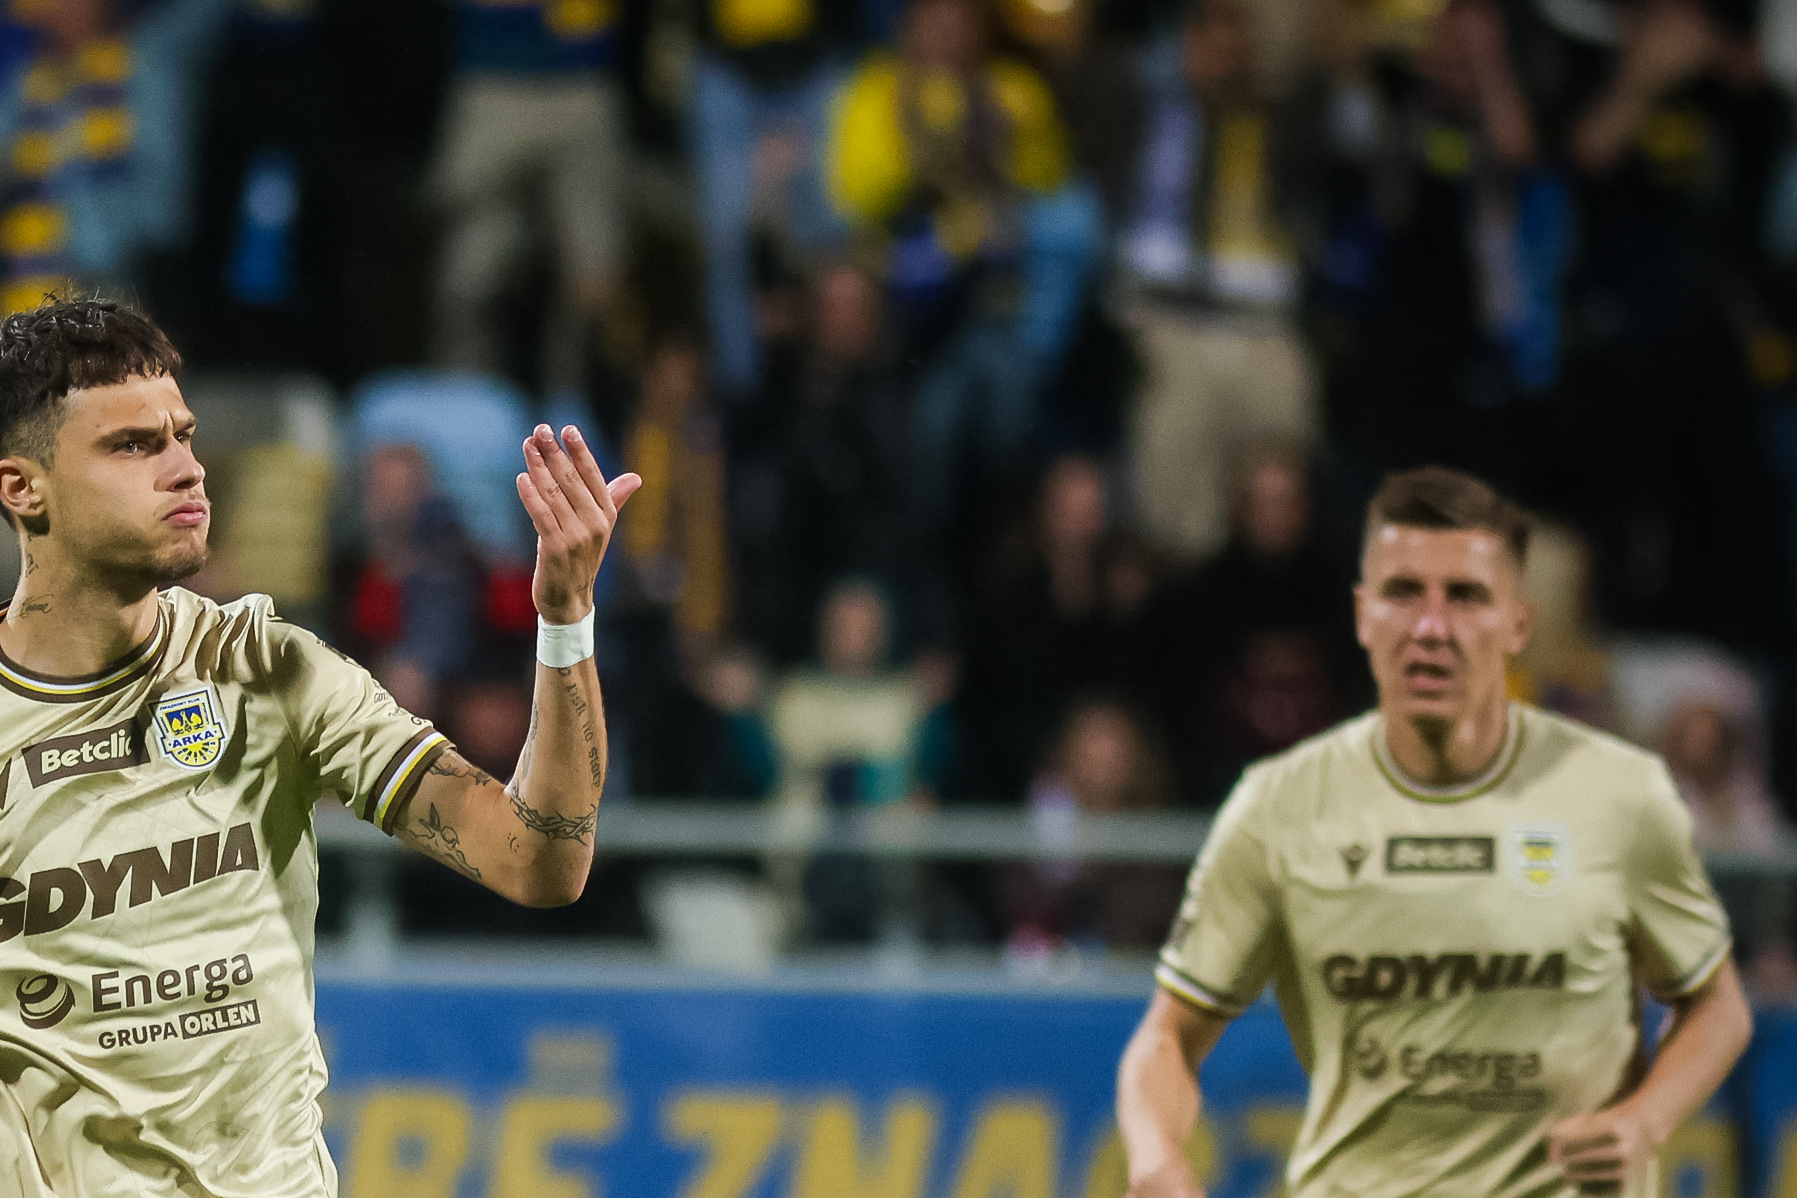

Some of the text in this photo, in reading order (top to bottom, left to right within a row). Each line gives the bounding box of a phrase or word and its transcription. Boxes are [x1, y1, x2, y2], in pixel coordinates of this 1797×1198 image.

[172, 730, 214, 749] ARKA
[91, 953, 254, 1013] Energa
[1322, 951, 1566, 1001] GDYNIA
[98, 1002, 257, 1050] GRUPA ORLEN
